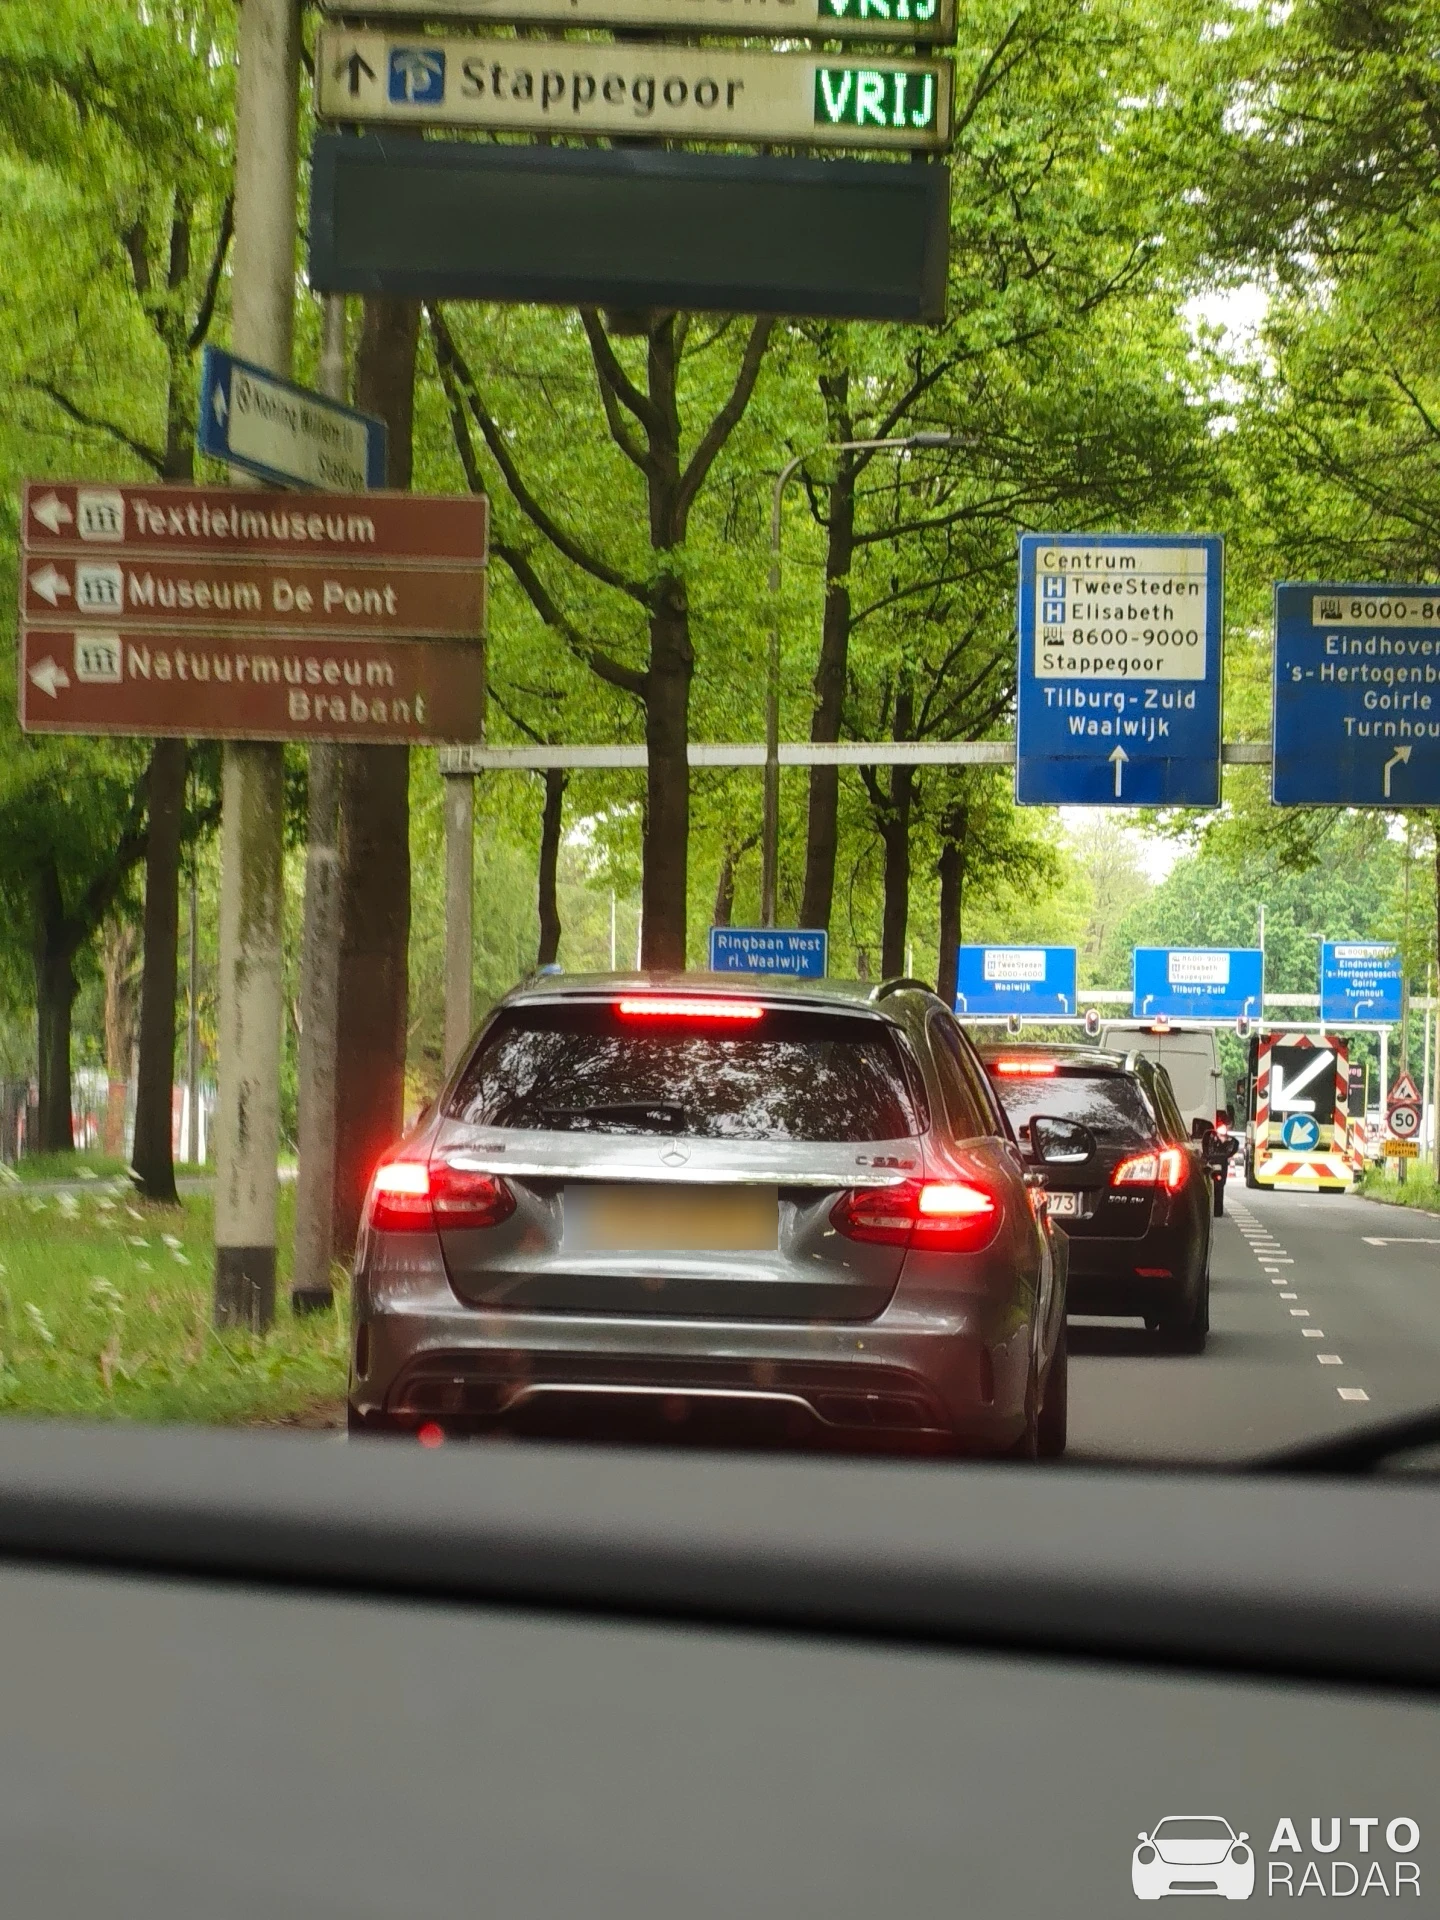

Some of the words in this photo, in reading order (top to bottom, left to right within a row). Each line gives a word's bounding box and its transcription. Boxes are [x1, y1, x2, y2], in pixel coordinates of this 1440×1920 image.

[460, 56, 744, 118] Stappegoor
[821, 69, 932, 128] VRIJ
[130, 498, 375, 542] Textielmuseum
[1043, 552, 1136, 569] Centrum
[128, 571, 262, 611] Museum
[272, 577, 313, 613] De
[323, 579, 398, 615] Pont
[1072, 578, 1199, 596] TweeSteden
[1072, 603, 1174, 620] Elisabeth
[1072, 628, 1198, 646] 8600-9000
[128, 643, 394, 688] Natuurmuseum
[1043, 653, 1163, 675] Stappegoor
[1286, 661, 1440, 687] 's-Hertogenb
[288, 687, 428, 725] Brabant
[1043, 687, 1196, 713] Tilburg-Zuid
[1364, 690, 1432, 710] Goirle
[1069, 716, 1169, 742] Waalwijk
[718, 935, 784, 953] Ringbaan
[788, 937, 820, 951] West
[748, 953, 809, 972] Waalwijk
[1340, 960, 1382, 968] Eindhoven
[995, 983, 1031, 993] Waalwijk
[1345, 988, 1384, 997] Turnhout
[1352, 979, 1377, 987] Goirle
[1395, 1114, 1414, 1127] 50
